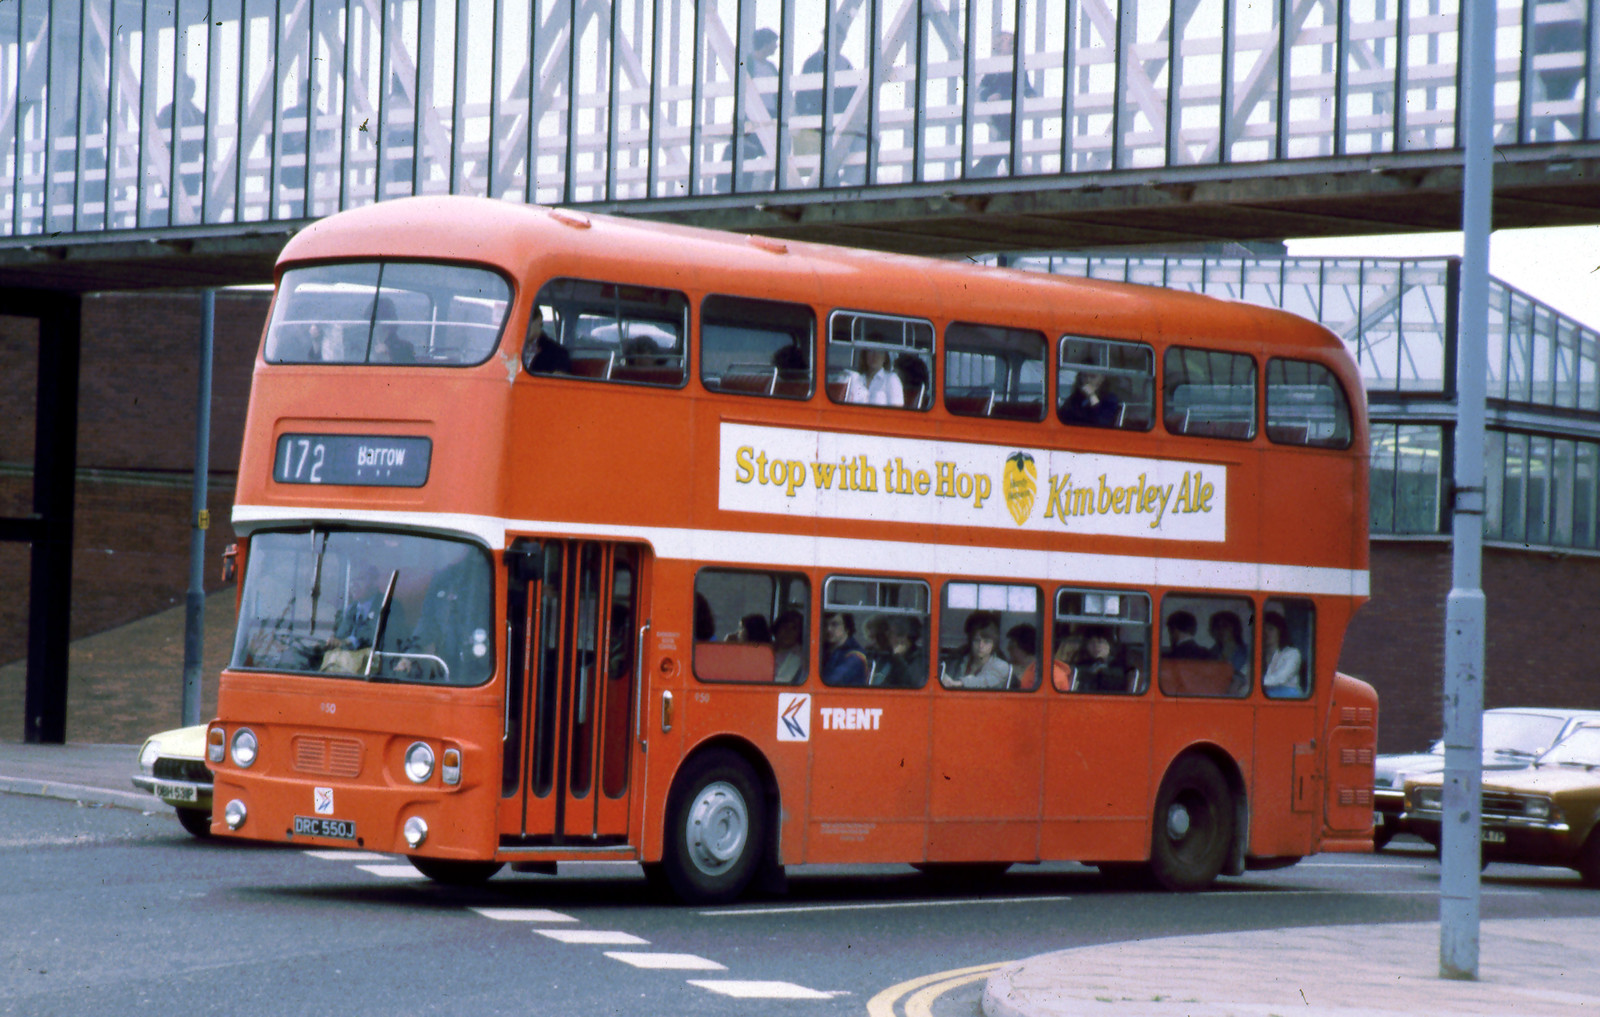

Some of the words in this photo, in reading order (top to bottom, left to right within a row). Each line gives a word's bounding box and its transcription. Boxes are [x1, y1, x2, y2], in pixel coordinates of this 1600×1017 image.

[283, 439, 325, 482] 172
[357, 446, 406, 466] Barrow
[735, 445, 806, 497] Stop
[809, 455, 878, 492] with
[883, 457, 931, 495] the
[934, 460, 992, 508] Hop
[1043, 473, 1174, 529] Kimberley
[1171, 470, 1214, 513] Ale
[820, 707, 883, 730] TRENT
[295, 818, 319, 834] DRC
[321, 820, 354, 838] 550J
